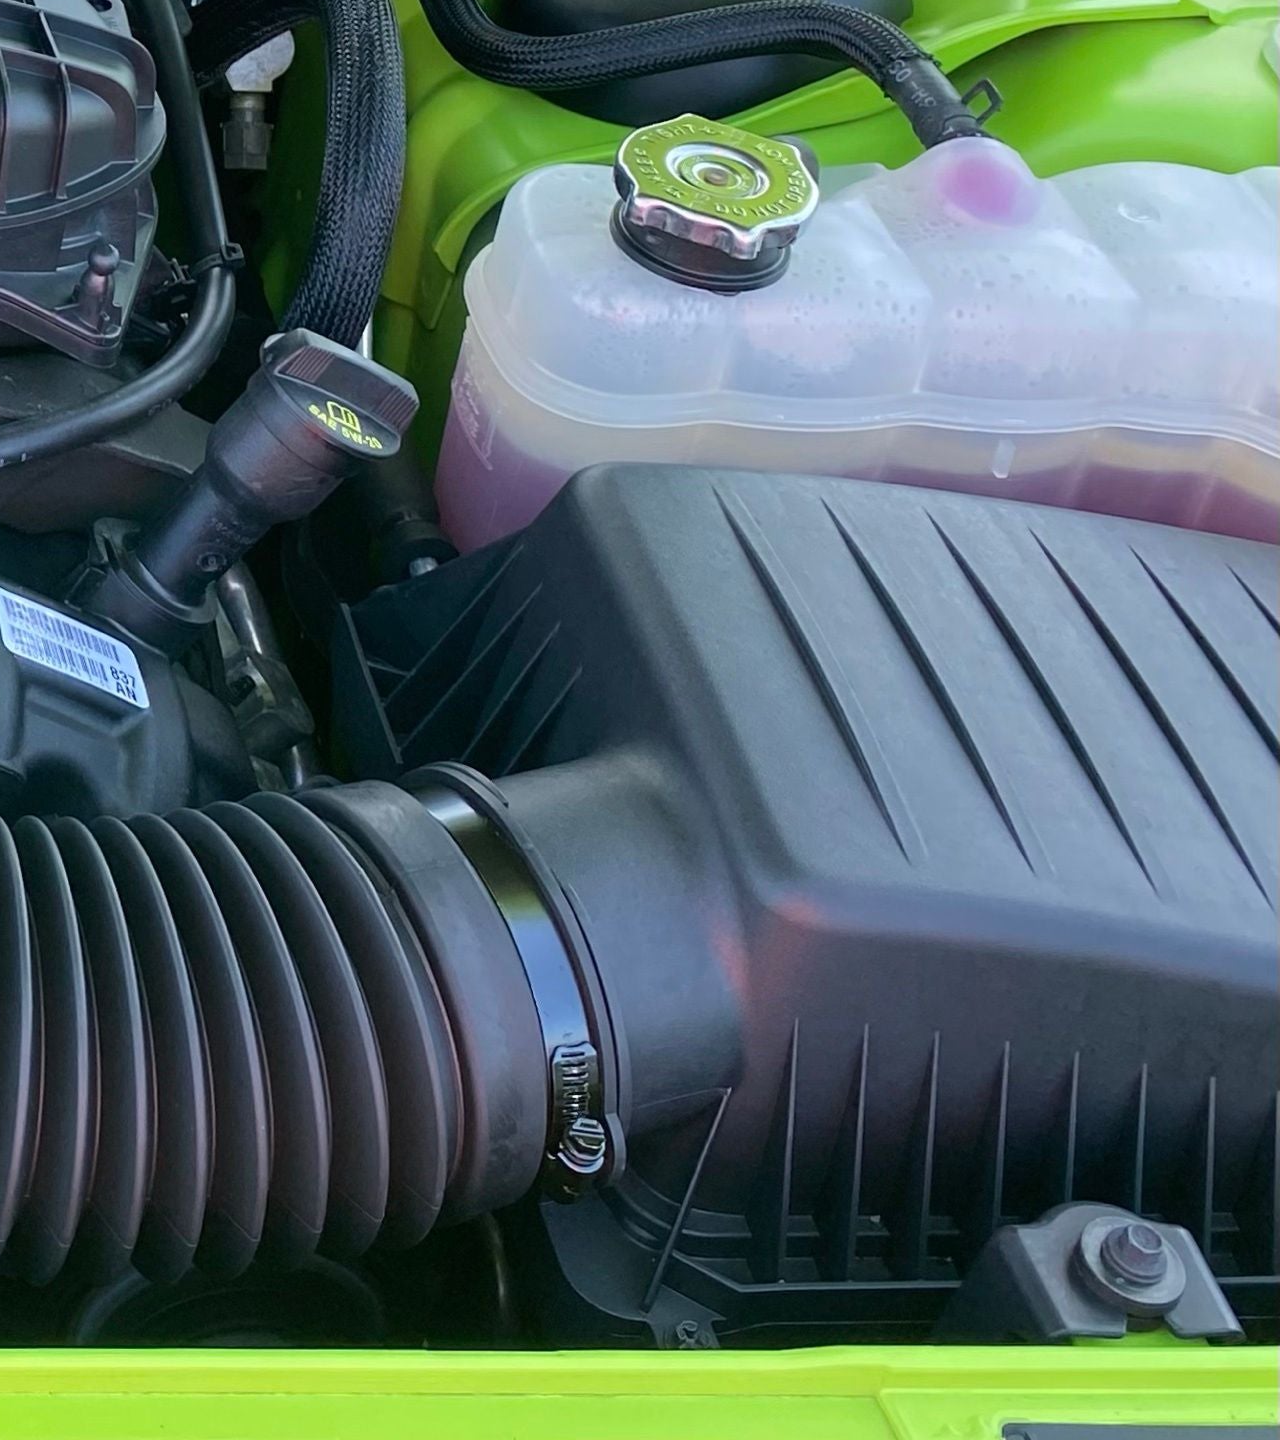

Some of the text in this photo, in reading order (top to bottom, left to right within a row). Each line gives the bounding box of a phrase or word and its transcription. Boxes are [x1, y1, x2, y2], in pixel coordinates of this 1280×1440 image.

[640, 123, 696, 144] TIGHT
[714, 201, 747, 217] DO
[749, 199, 793, 217] NOT
[785, 169, 807, 203] OPEN
[308, 404, 383, 449] SAE 5W-20
[110, 665, 136, 688] 837
[116, 681, 137, 702] AN
